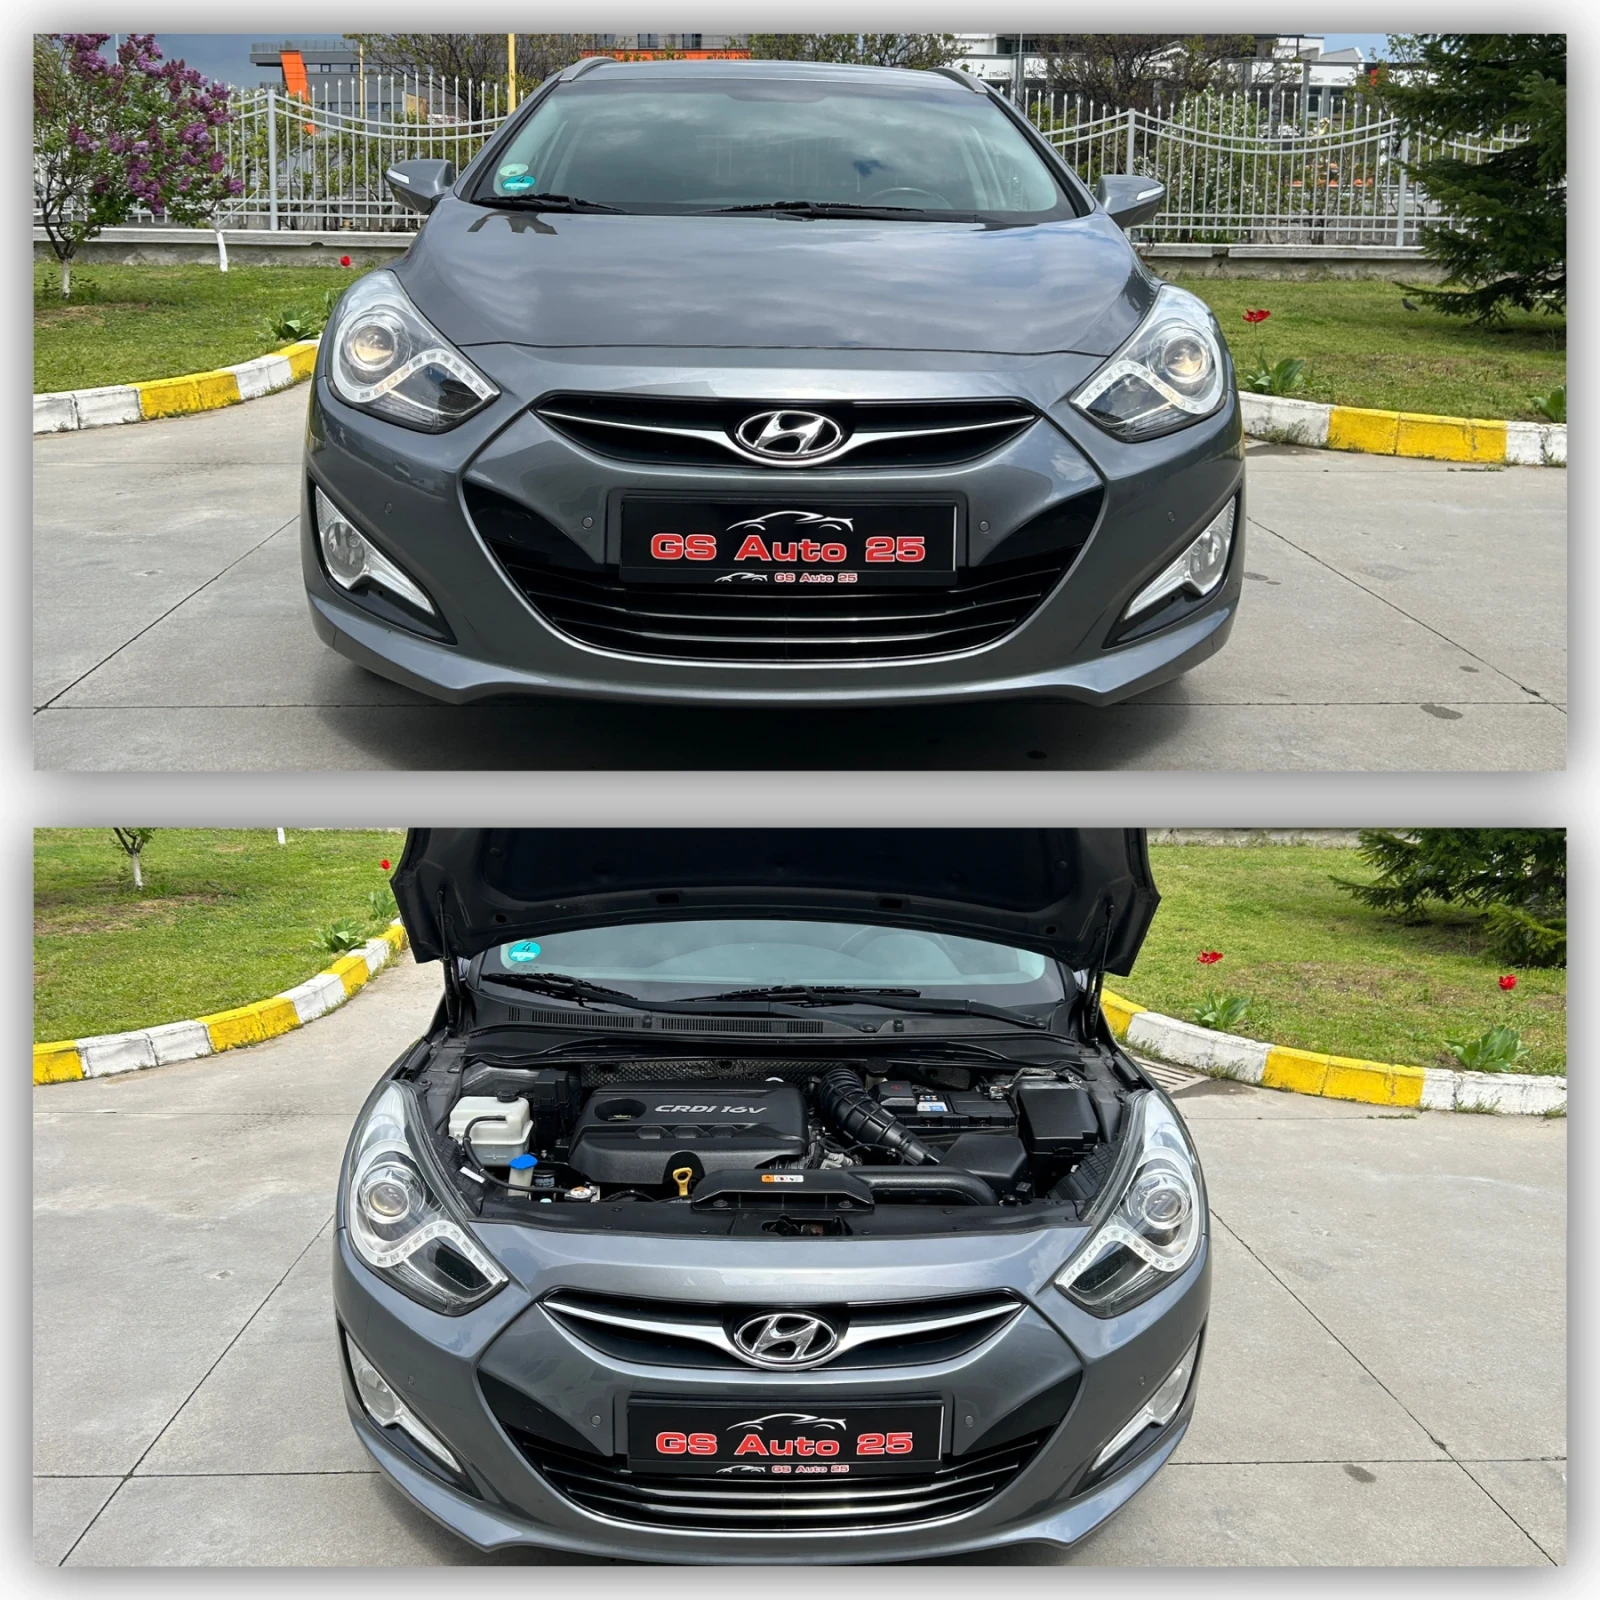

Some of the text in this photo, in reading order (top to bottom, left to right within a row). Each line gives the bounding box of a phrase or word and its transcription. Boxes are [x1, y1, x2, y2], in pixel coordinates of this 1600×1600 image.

[650, 533, 926, 563] GS Auto 25
[774, 572, 858, 583] GS Auto 25
[521, 942, 531, 952] 4
[654, 1104, 768, 1114] CRDI 16V
[656, 1431, 914, 1456] GS Auto 25
[771, 1464, 850, 1473] GS Auto 25
